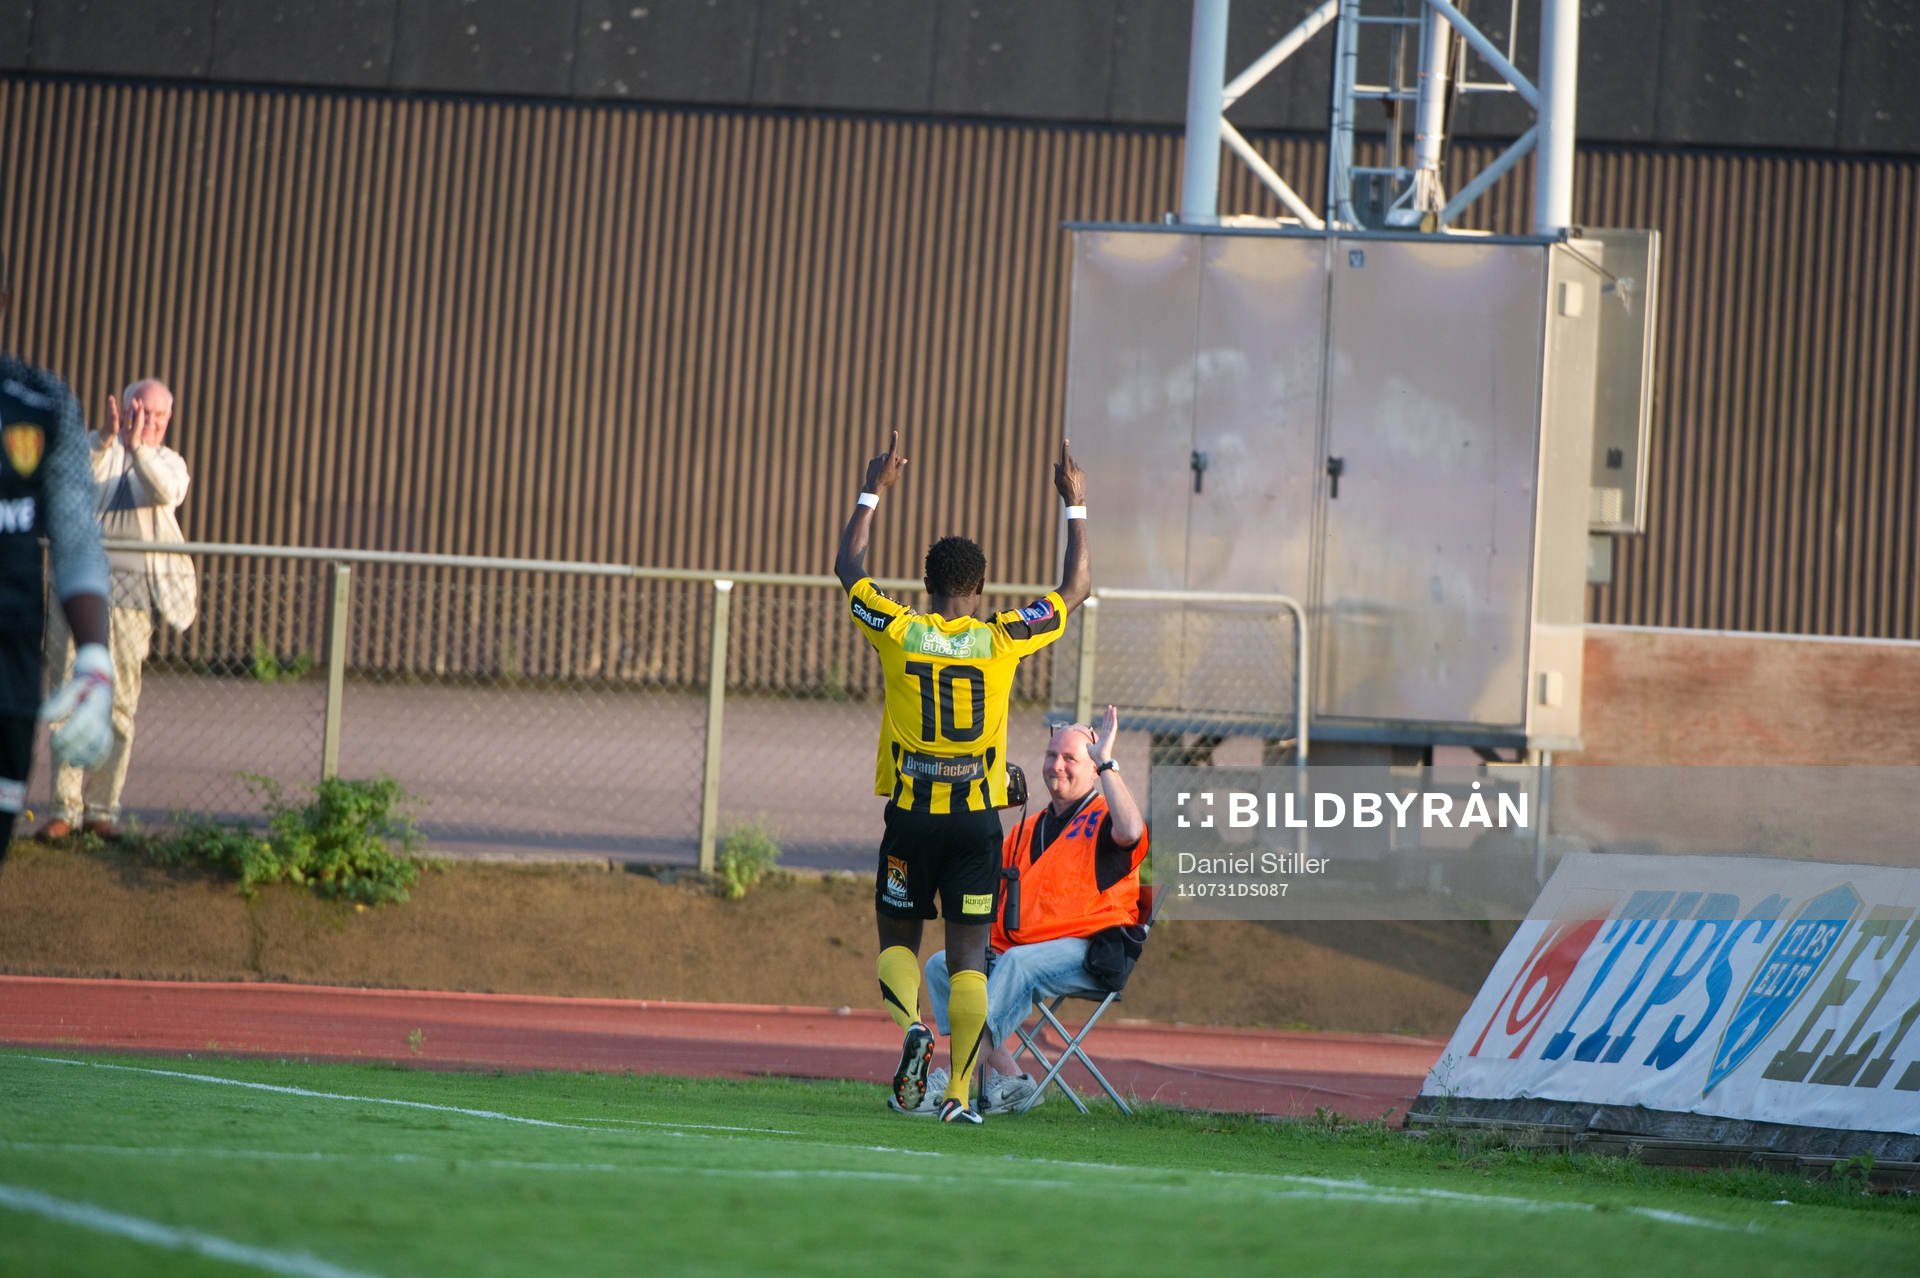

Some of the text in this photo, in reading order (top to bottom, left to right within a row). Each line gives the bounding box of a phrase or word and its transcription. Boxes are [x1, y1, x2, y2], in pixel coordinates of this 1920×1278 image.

[905, 661, 985, 742] 10
[906, 756, 978, 776] BrandFactory
[1066, 809, 1103, 839] 25
[1781, 922, 1838, 958] TIPS
[1539, 889, 1792, 1071] TIPS
[1754, 963, 1812, 998] ELIT
